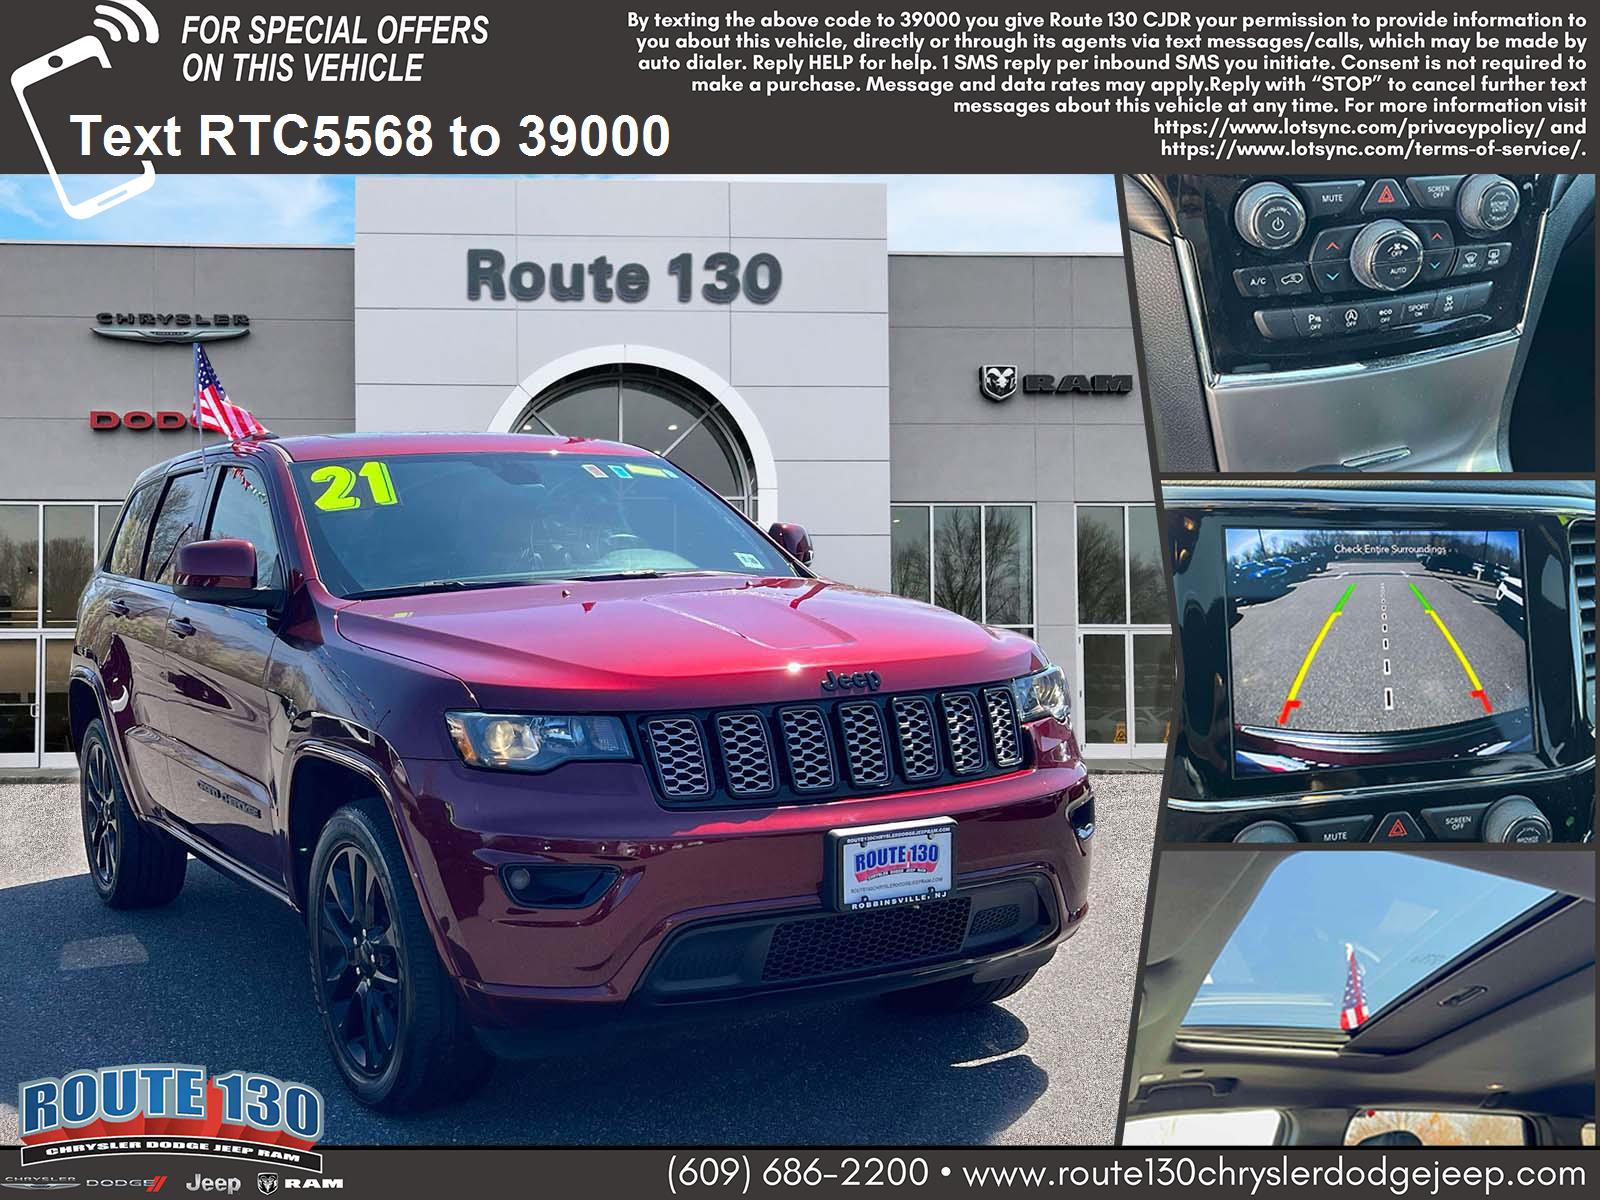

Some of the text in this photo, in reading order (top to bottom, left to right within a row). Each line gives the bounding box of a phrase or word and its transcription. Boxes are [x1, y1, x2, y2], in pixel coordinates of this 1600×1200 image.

[1321, 194, 1344, 203] MUTE
[466, 248, 783, 305] Route 130
[1390, 267, 1407, 275] AUTO
[1250, 278, 1267, 286] A/C
[1408, 303, 1430, 312] SPORT
[95, 312, 251, 327] CHRYSLER
[1023, 373, 1134, 395] RAM
[310, 461, 400, 512] 21
[1334, 544, 1447, 555] Check Entire Surroundings
[820, 669, 881, 691] Jeep
[1445, 816, 1472, 825] SCREEN
[1452, 823, 1464, 831] OFF
[1323, 832, 1347, 841] MUTE
[855, 845, 939, 872] ROUTE 130
[852, 891, 947, 910] ROBBINSVILLE, NJ
